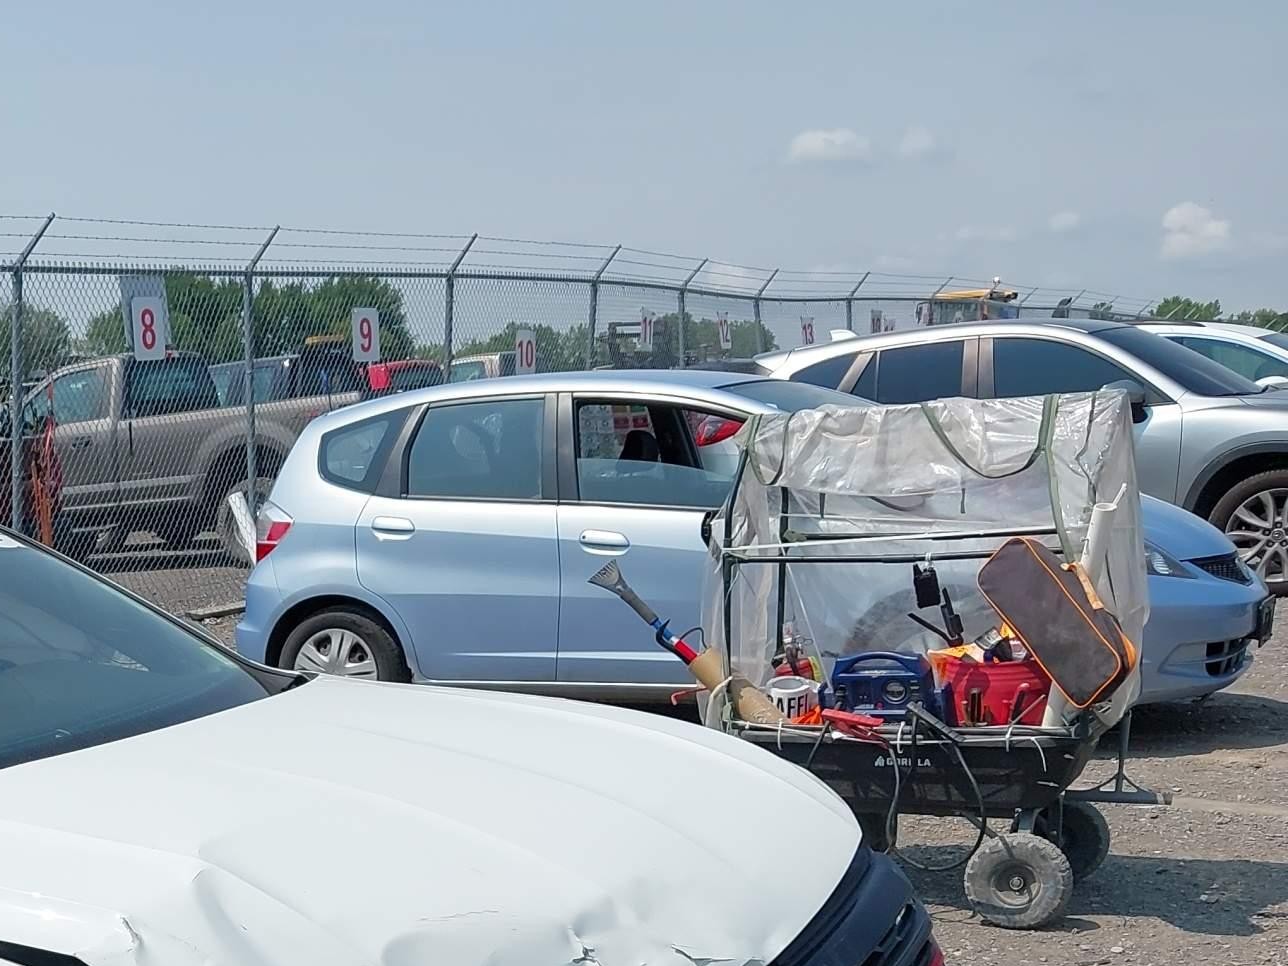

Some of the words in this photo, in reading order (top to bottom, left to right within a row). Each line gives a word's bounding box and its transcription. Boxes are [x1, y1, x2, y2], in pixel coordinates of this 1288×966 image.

[141, 308, 157, 350] 8
[360, 317, 373, 352] 9
[518, 340, 534, 368] 10
